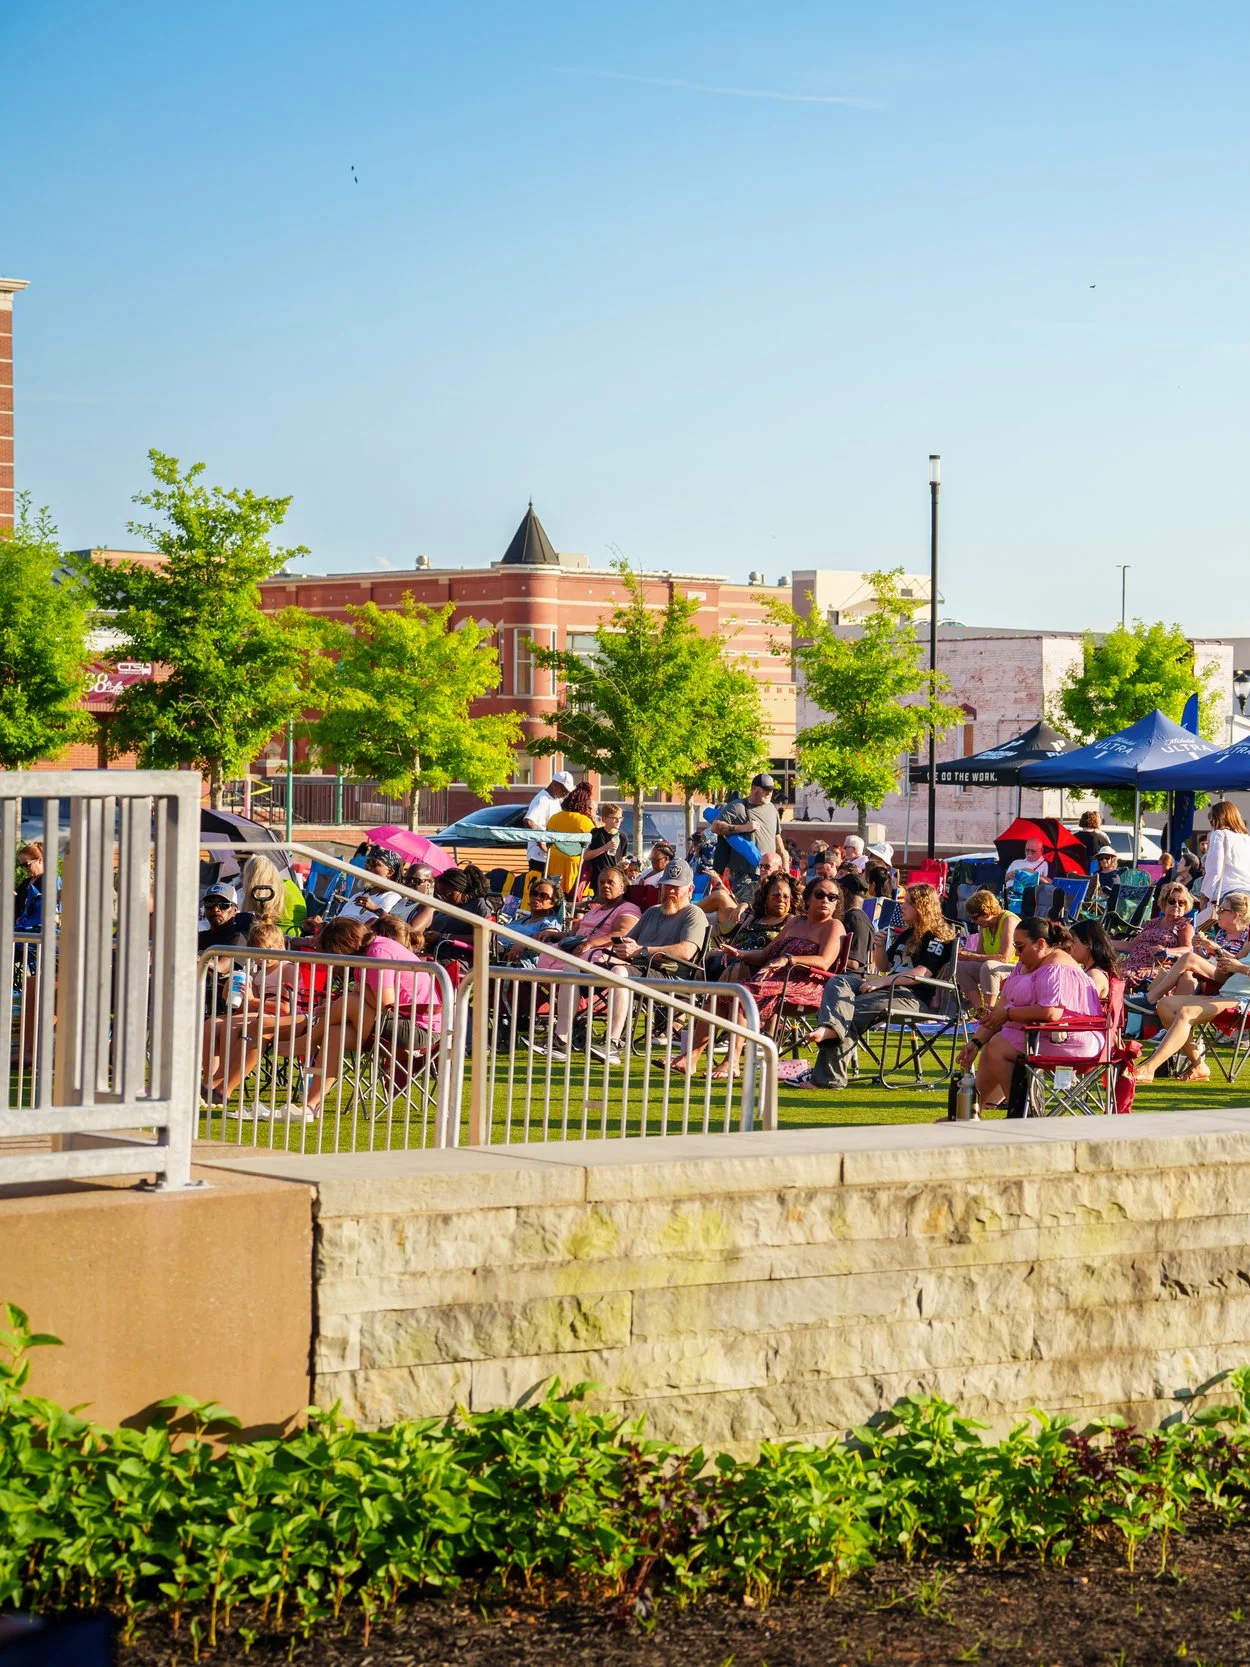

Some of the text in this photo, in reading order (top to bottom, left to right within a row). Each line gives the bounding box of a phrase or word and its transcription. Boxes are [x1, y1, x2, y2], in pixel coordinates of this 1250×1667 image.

[1094, 742, 1134, 754] ULTRA
[1160, 744, 1214, 753] ULTRA
[954, 772, 970, 782] THE
[972, 772, 998, 782] WORK.
[926, 940, 945, 956] 56
